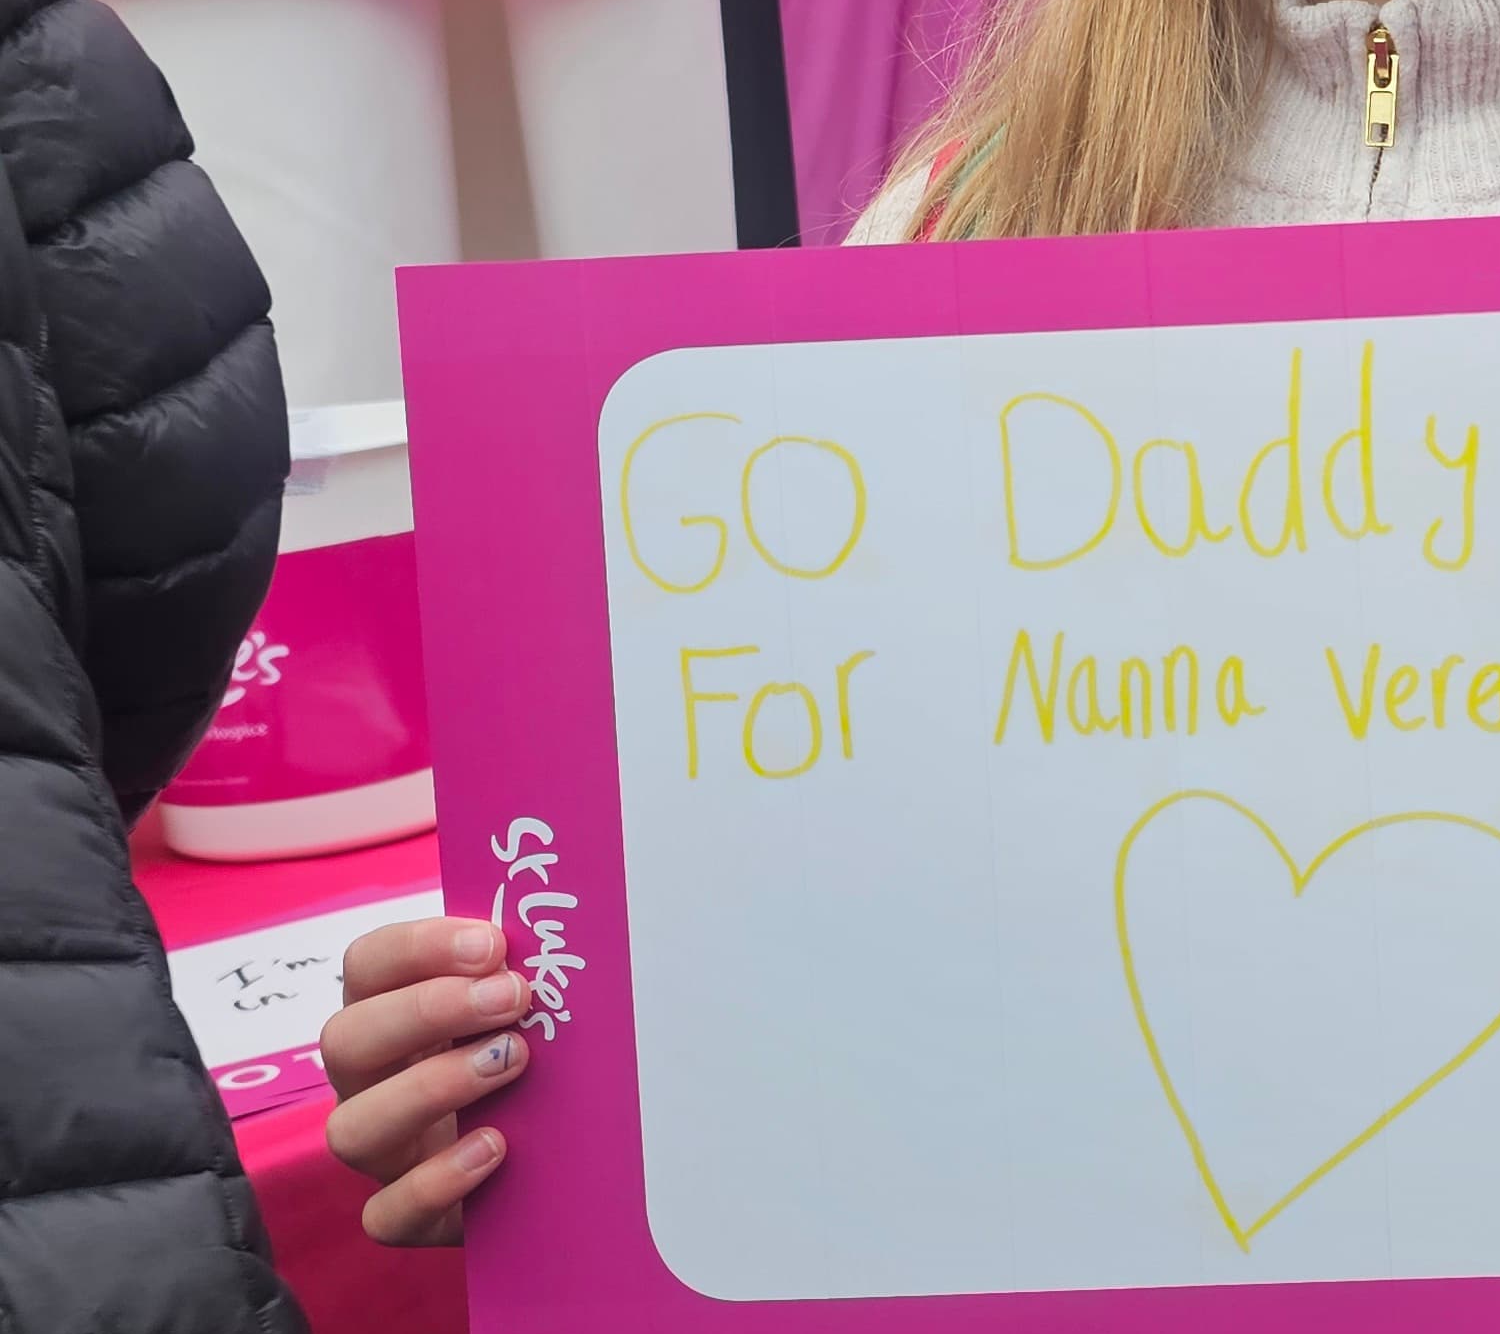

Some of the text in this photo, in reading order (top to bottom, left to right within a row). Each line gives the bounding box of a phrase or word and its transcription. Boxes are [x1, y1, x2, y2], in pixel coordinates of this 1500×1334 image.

[998, 338, 1481, 573] Daddy
[680, 643, 877, 781] For
[993, 627, 1267, 746] Nanna
